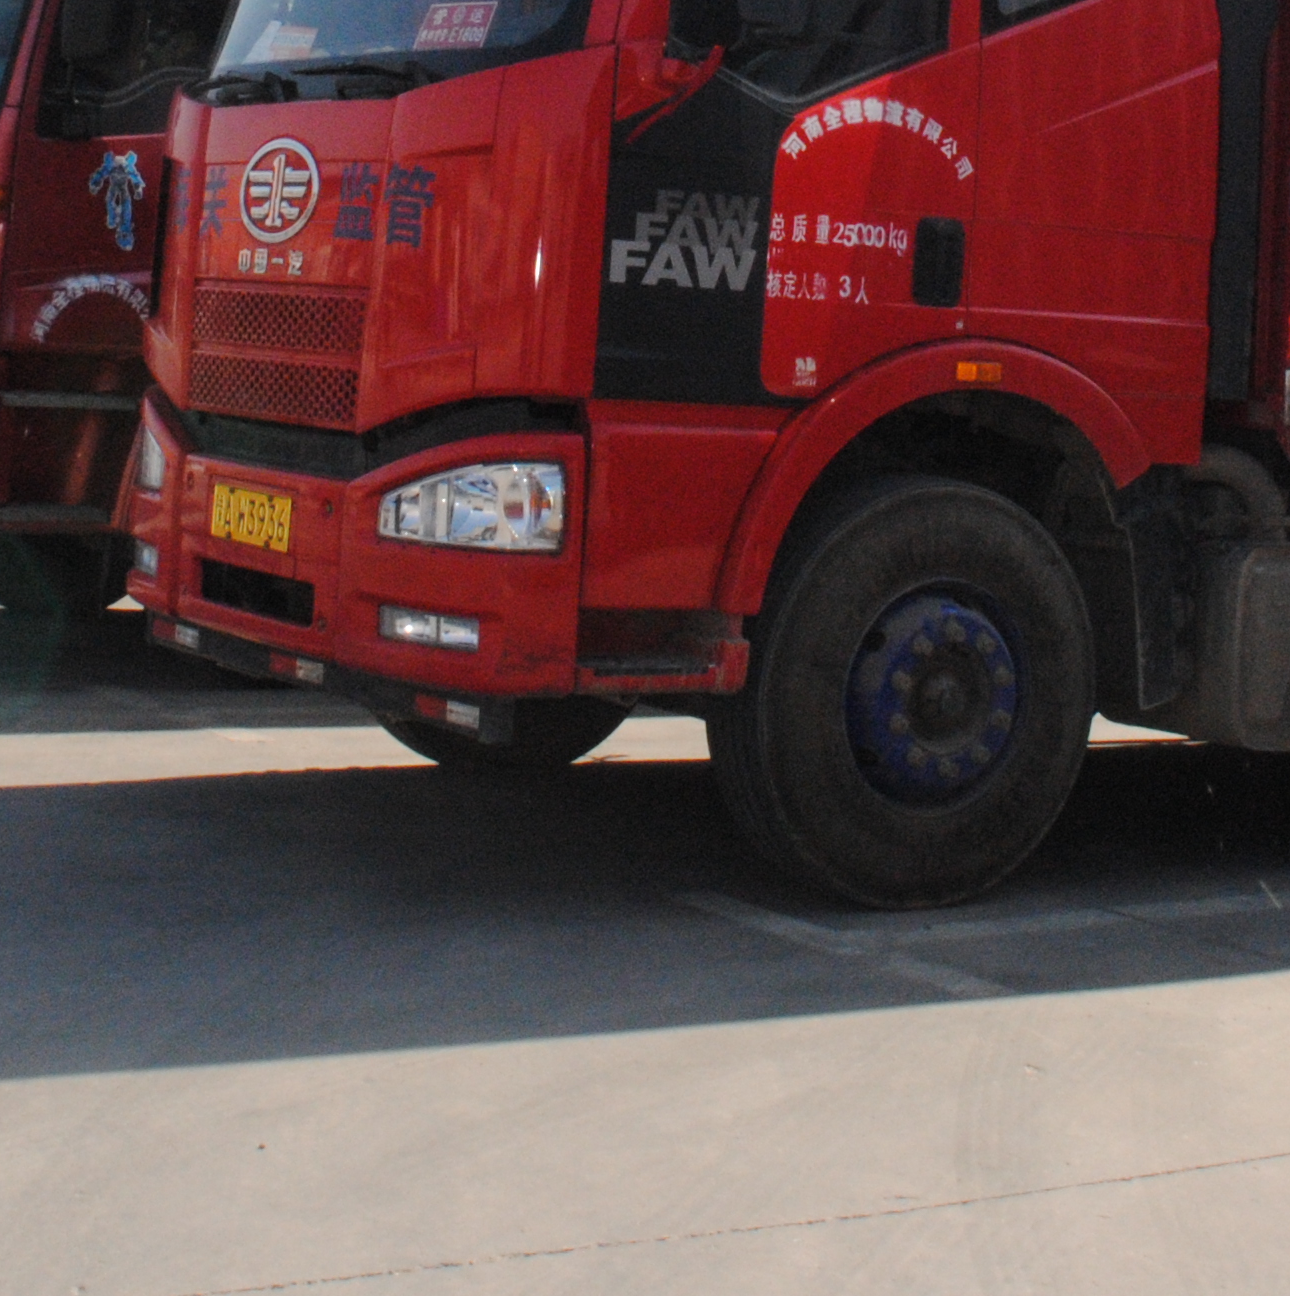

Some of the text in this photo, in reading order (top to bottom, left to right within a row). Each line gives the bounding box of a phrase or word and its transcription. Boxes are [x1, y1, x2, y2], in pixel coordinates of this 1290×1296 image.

[781, 96, 974, 181] 河南全程物流有限公司
[333, 161, 436, 247] 监管
[609, 238, 757, 292] FAW
